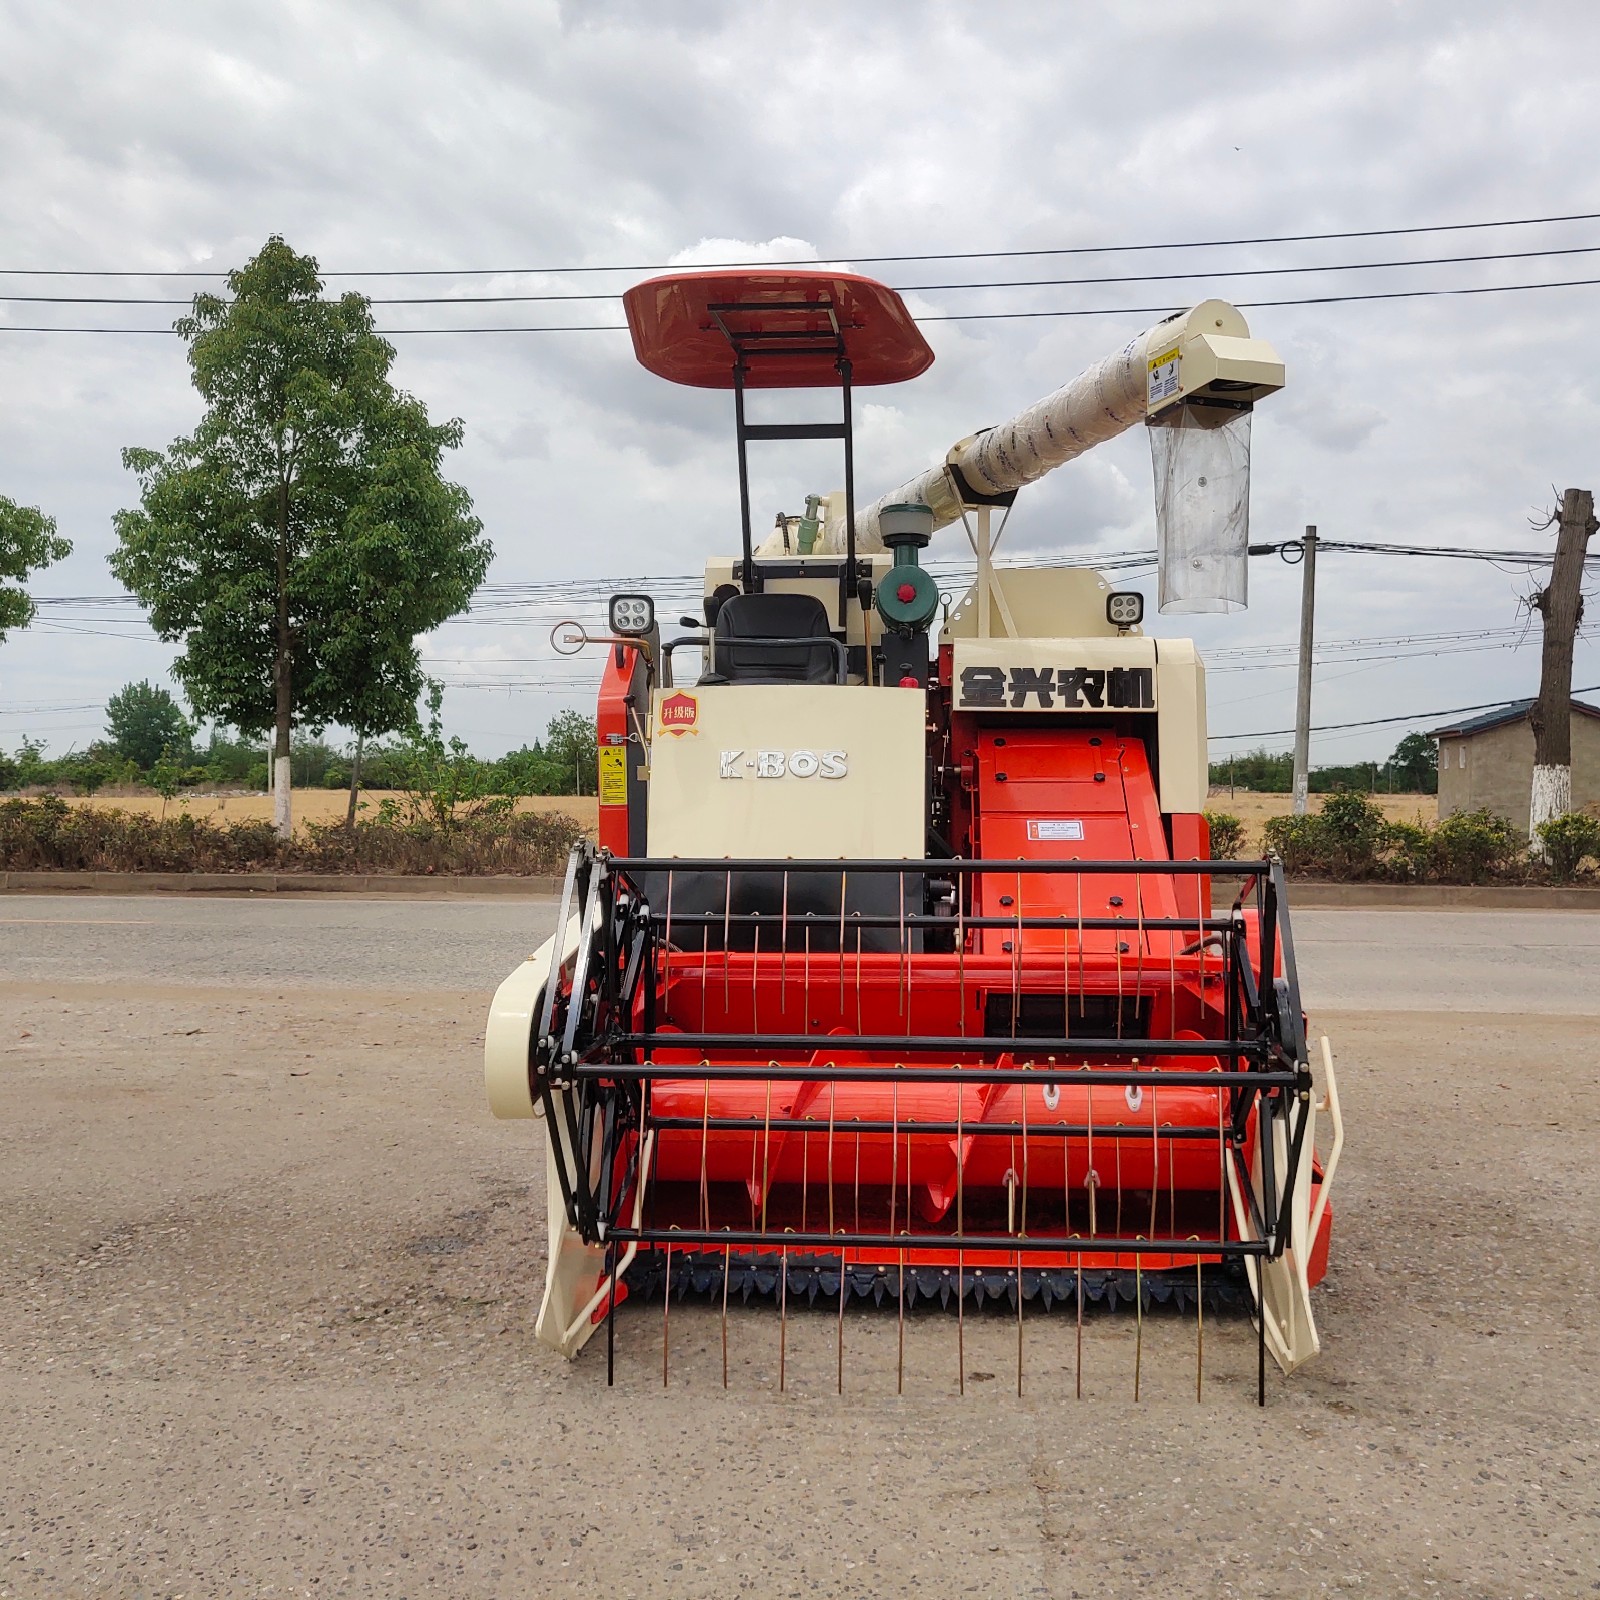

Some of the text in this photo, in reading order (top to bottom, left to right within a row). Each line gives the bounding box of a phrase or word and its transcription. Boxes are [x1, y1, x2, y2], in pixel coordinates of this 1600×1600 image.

[959, 666, 1155, 708] 金兴农机
[663, 705, 695, 719] 升级版
